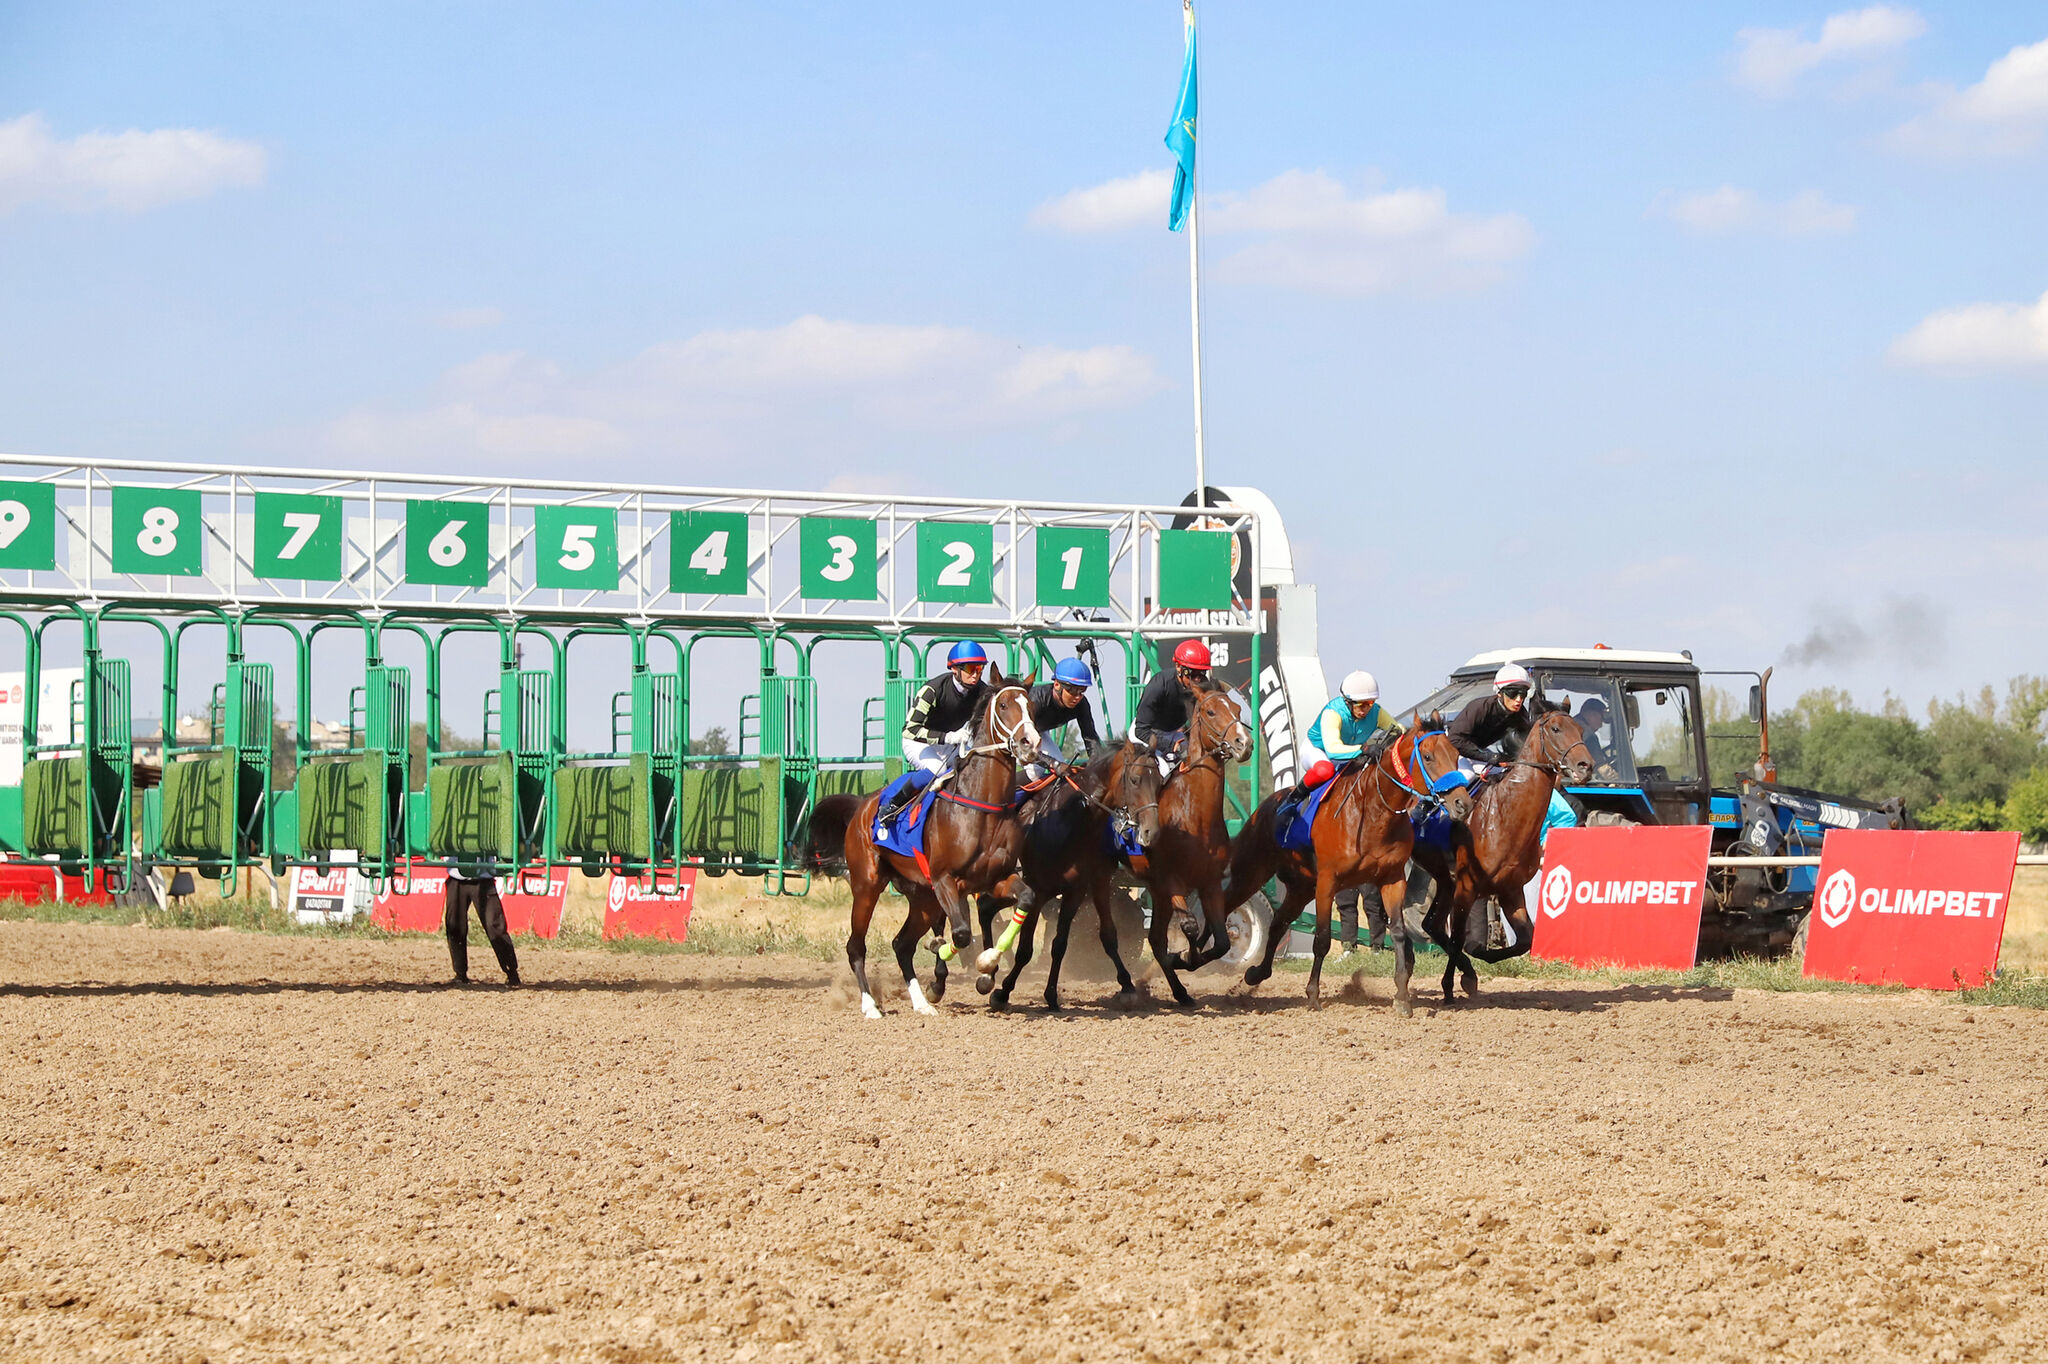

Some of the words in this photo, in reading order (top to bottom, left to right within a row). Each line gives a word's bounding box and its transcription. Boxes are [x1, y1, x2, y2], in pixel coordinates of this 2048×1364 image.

[0, 500, 31, 549] 9
[137, 507, 179, 557] 8
[277, 513, 321, 560] 7
[428, 520, 468, 567] 6
[558, 525, 597, 571] 5
[689, 531, 729, 575] 4
[819, 535, 858, 582] 3
[937, 541, 975, 586] 2
[1061, 547, 1083, 590] 1
[1210, 642, 1229, 667] 25
[1575, 880, 1698, 905] OLIMPBET
[1859, 887, 2004, 918] OLIMPBET
